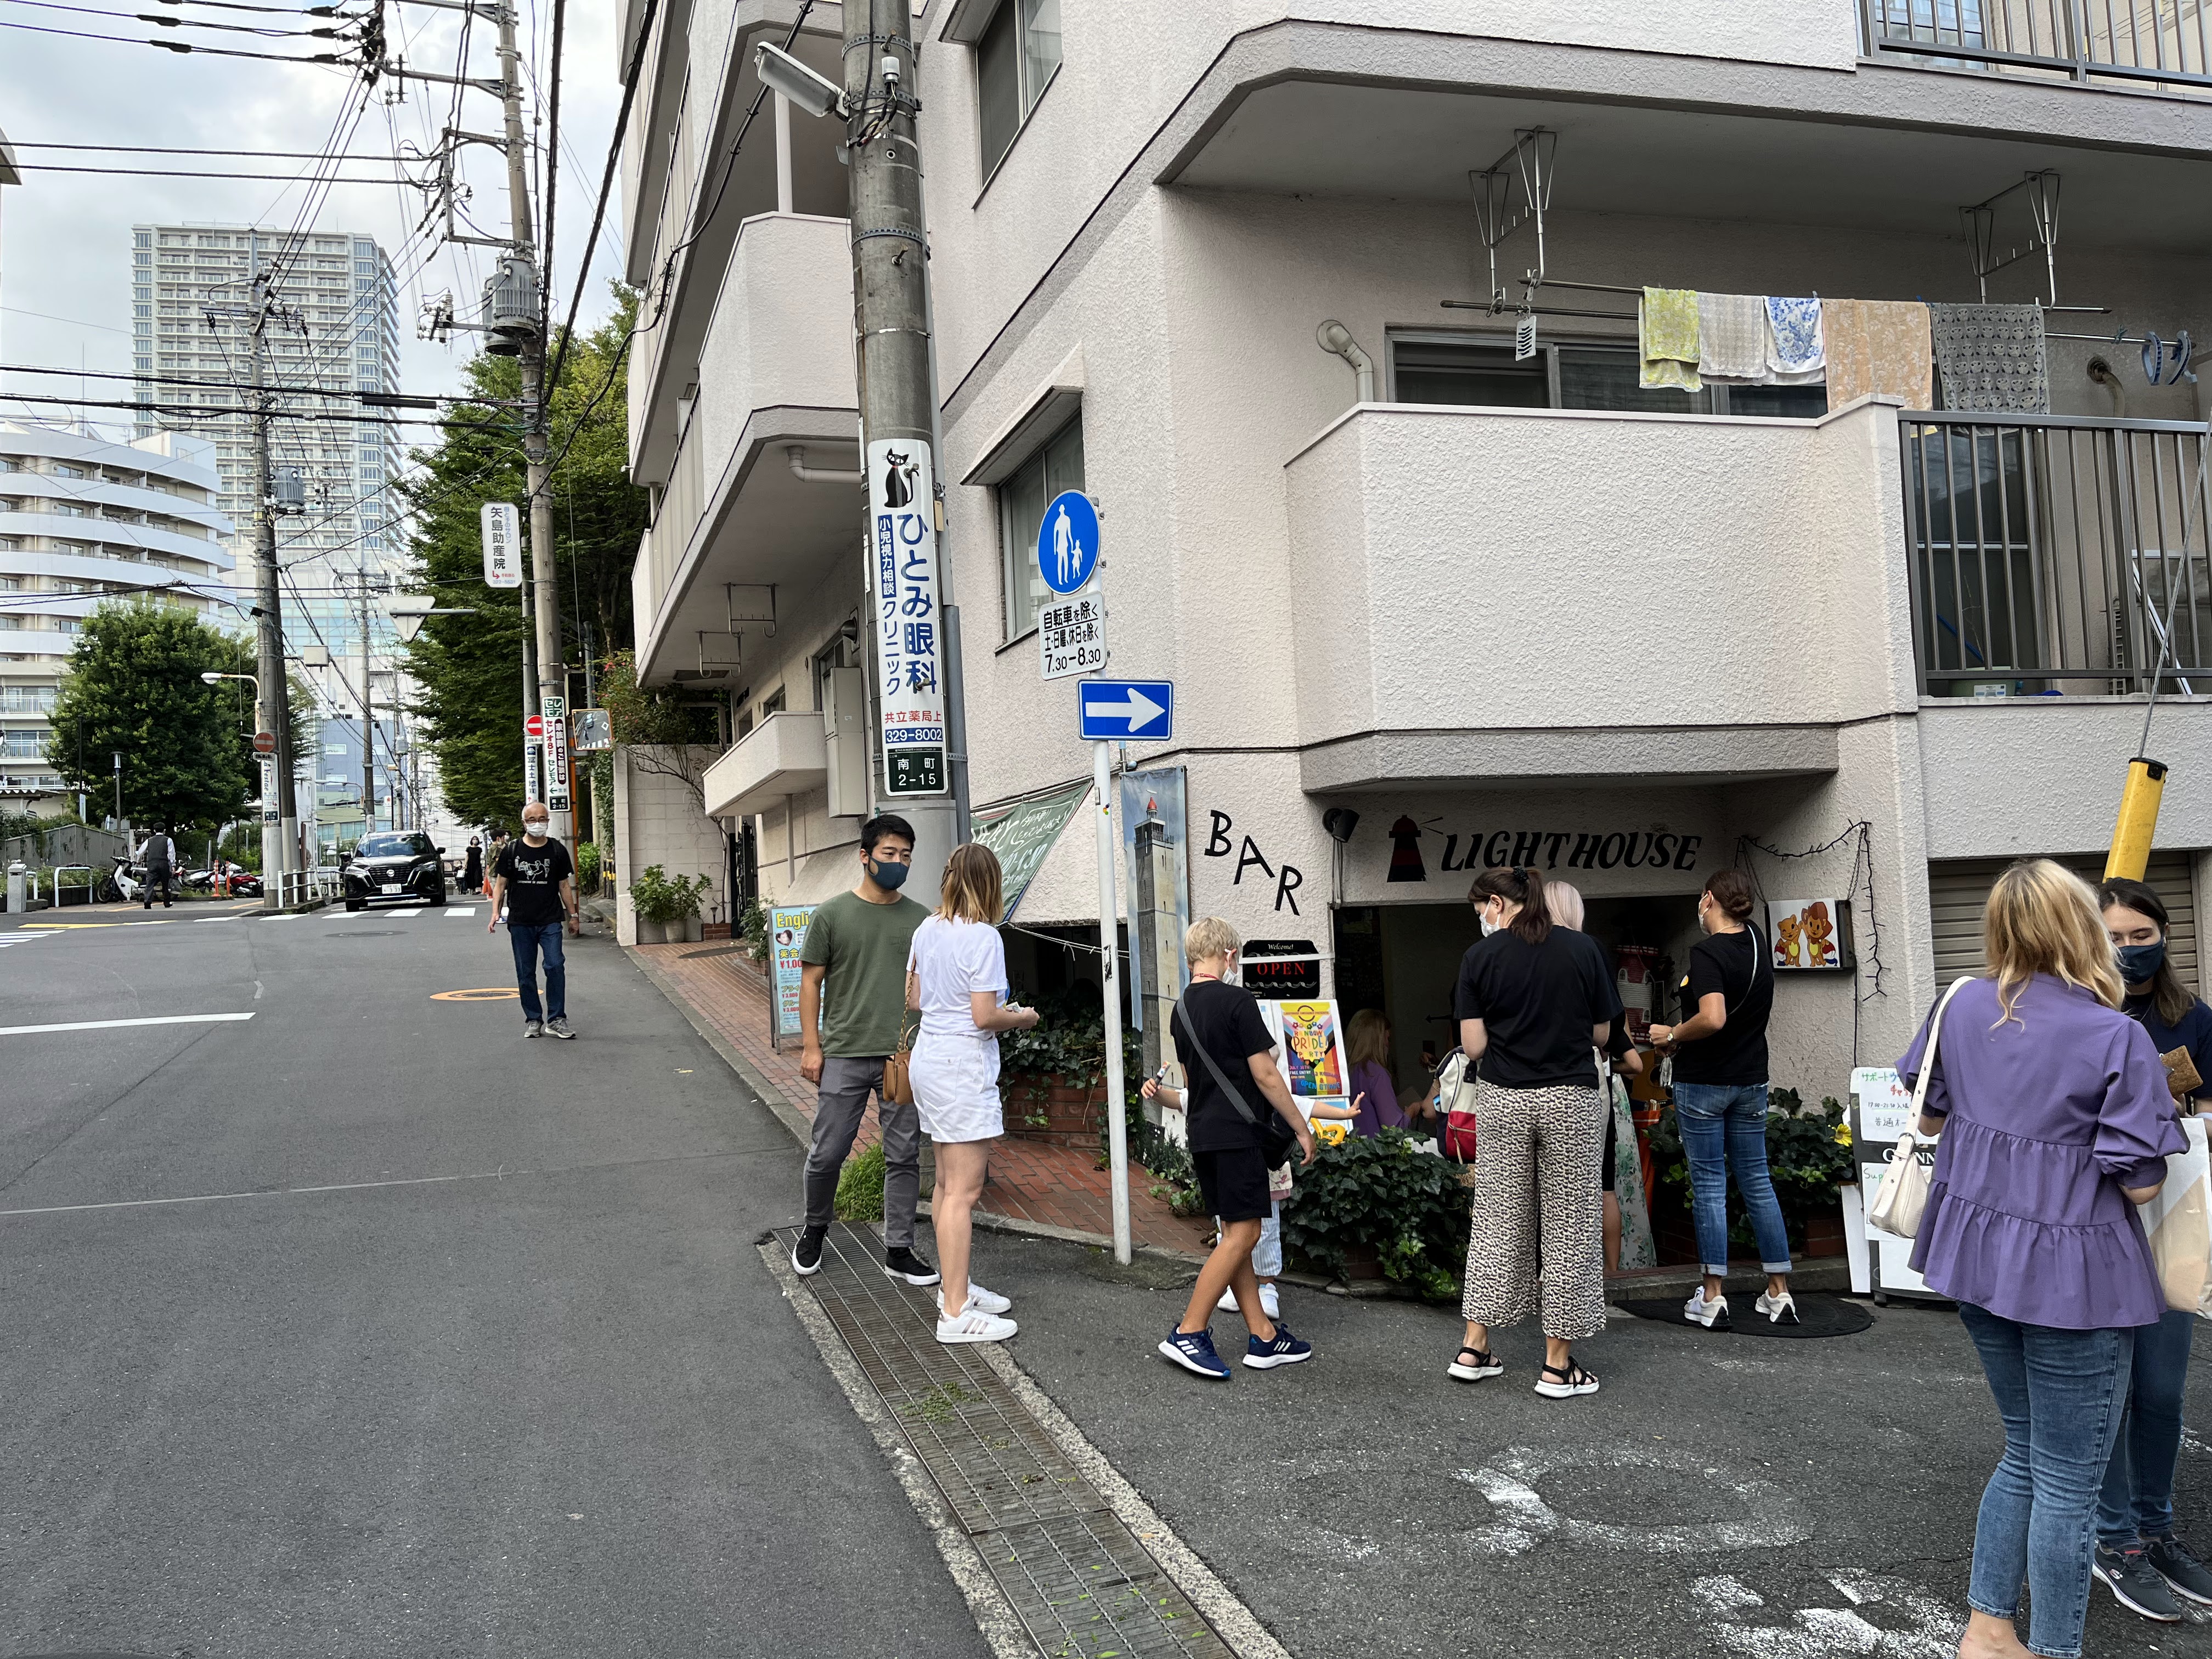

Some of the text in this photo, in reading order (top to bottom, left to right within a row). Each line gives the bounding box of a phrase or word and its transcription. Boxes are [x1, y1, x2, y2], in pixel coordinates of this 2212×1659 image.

[491, 506, 505, 569] 矢島助産院
[879, 517, 900, 696] 小児視力相談 クリニック
[897, 514, 936, 694] ひとみ眼科
[1044, 601, 1098, 629] 自転車を除く
[884, 710, 942, 724] 共立薬局上
[887, 729, 943, 742] 329-8002
[898, 773, 936, 786] 2-15
[1441, 830, 1702, 871] LIGHTHOUSE
[1204, 809, 1302, 916] BAR
[776, 911, 810, 930] Engli
[779, 947, 802, 959] 英会
[780, 959, 803, 969] ¥1,00
[1257, 962, 1305, 975] OPEN
[1293, 1036, 1328, 1051] PRIDE!
[1875, 1117, 1906, 1127] 普通オー
[1863, 1167, 1883, 1183] Sup
